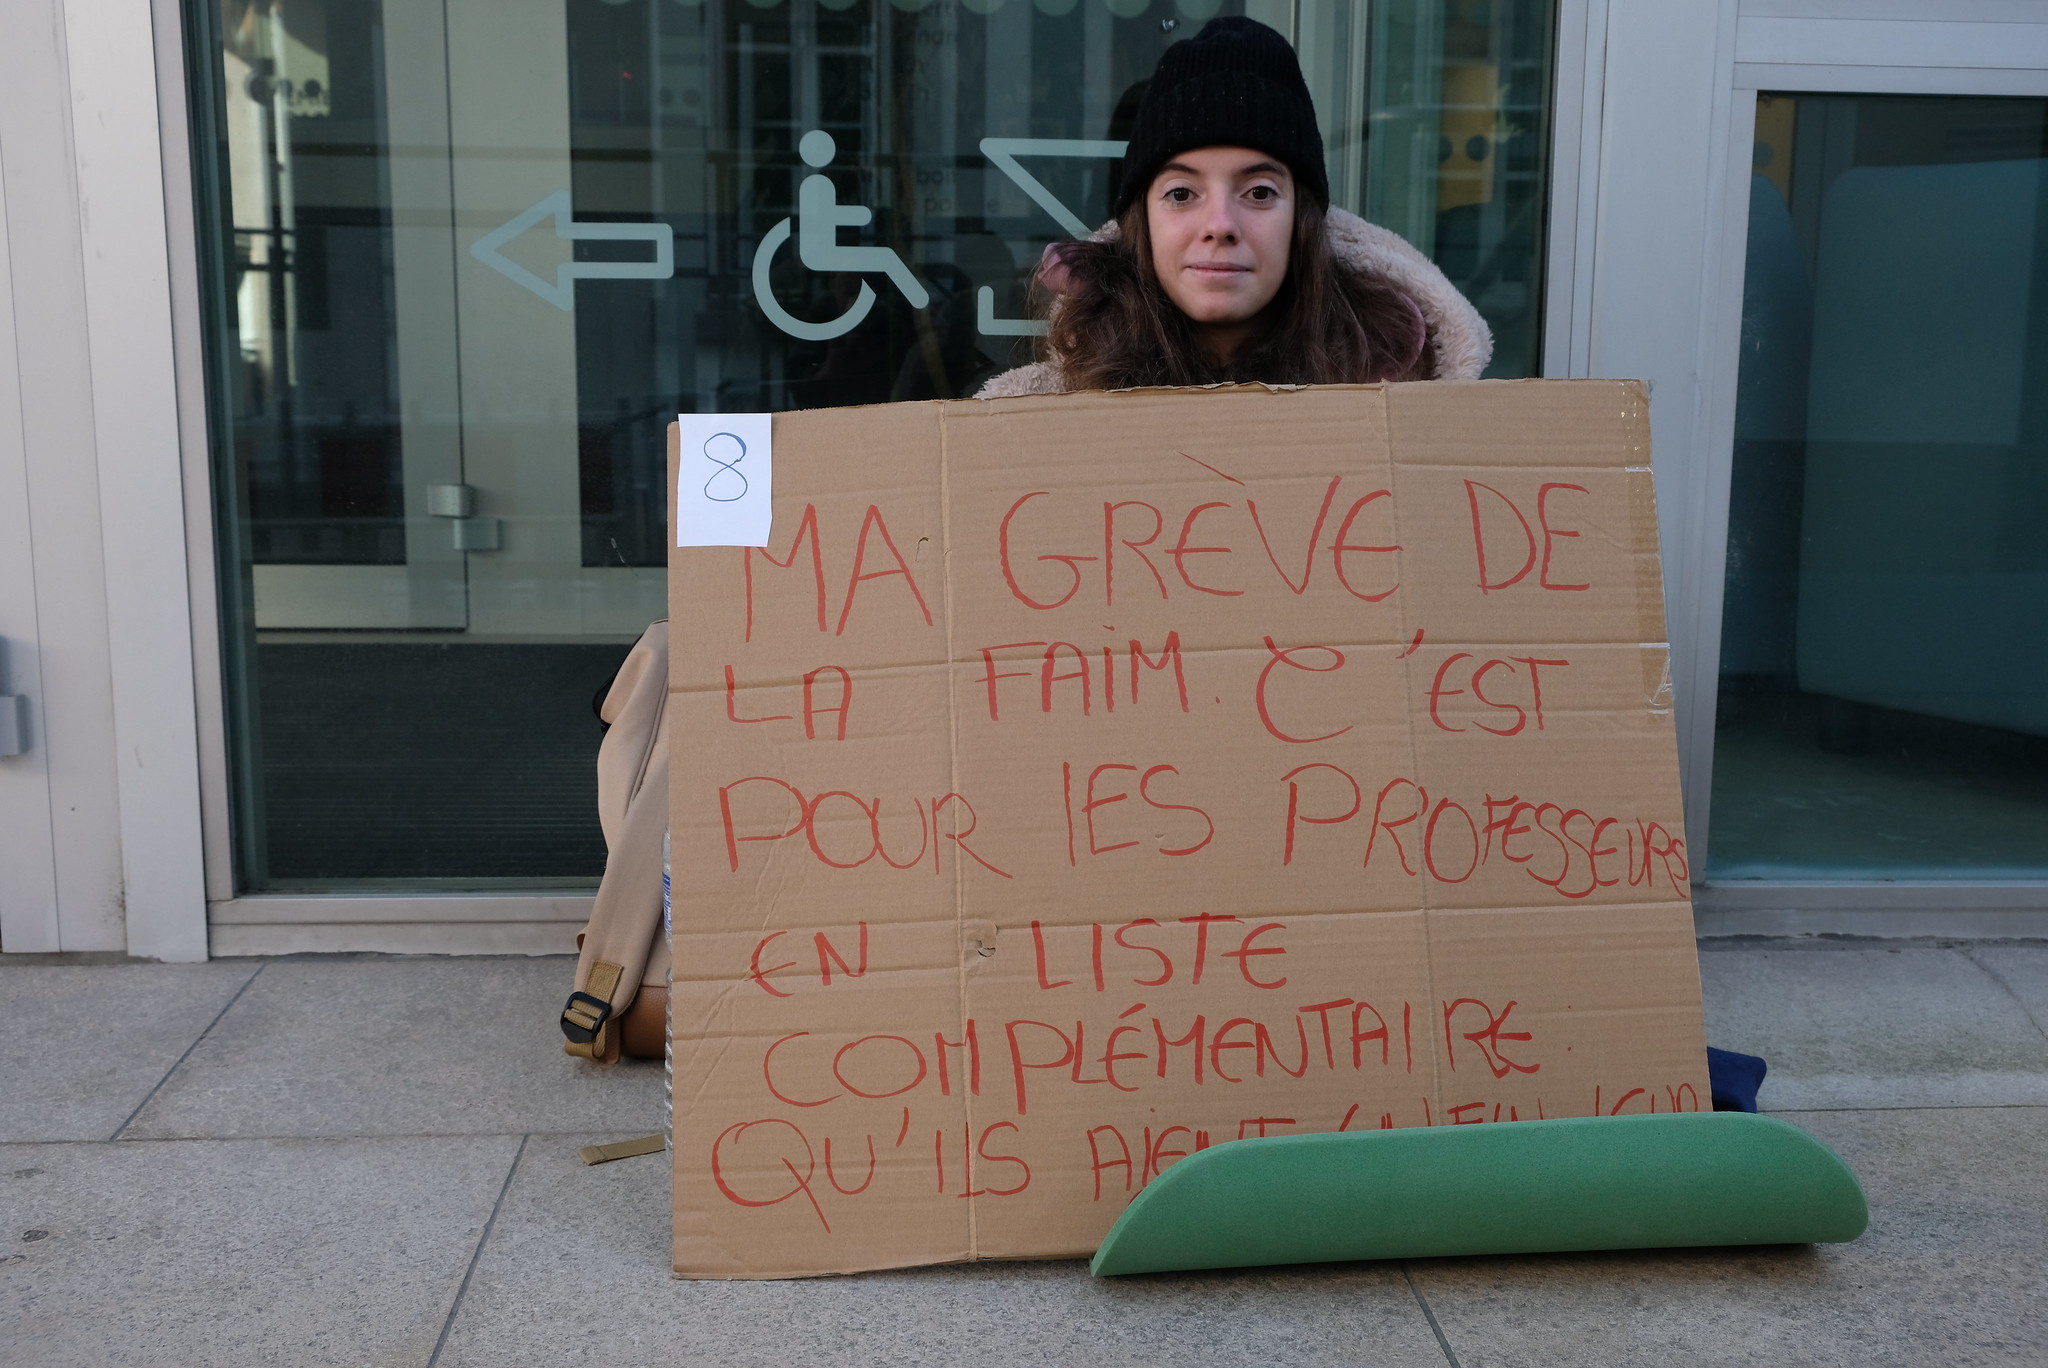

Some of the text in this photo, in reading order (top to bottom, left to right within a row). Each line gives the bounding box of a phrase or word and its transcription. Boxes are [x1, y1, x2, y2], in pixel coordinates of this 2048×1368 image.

[703, 432, 748, 502] 8
[744, 452, 1590, 642] MA GRÈVE DE
[725, 665, 852, 740] LA
[719, 777, 1013, 878] POUR
[1281, 763, 1688, 898] PROFESSEURS
[744, 912, 1288, 997] EN LISTE
[711, 1107, 1031, 1233] QU'ILS
